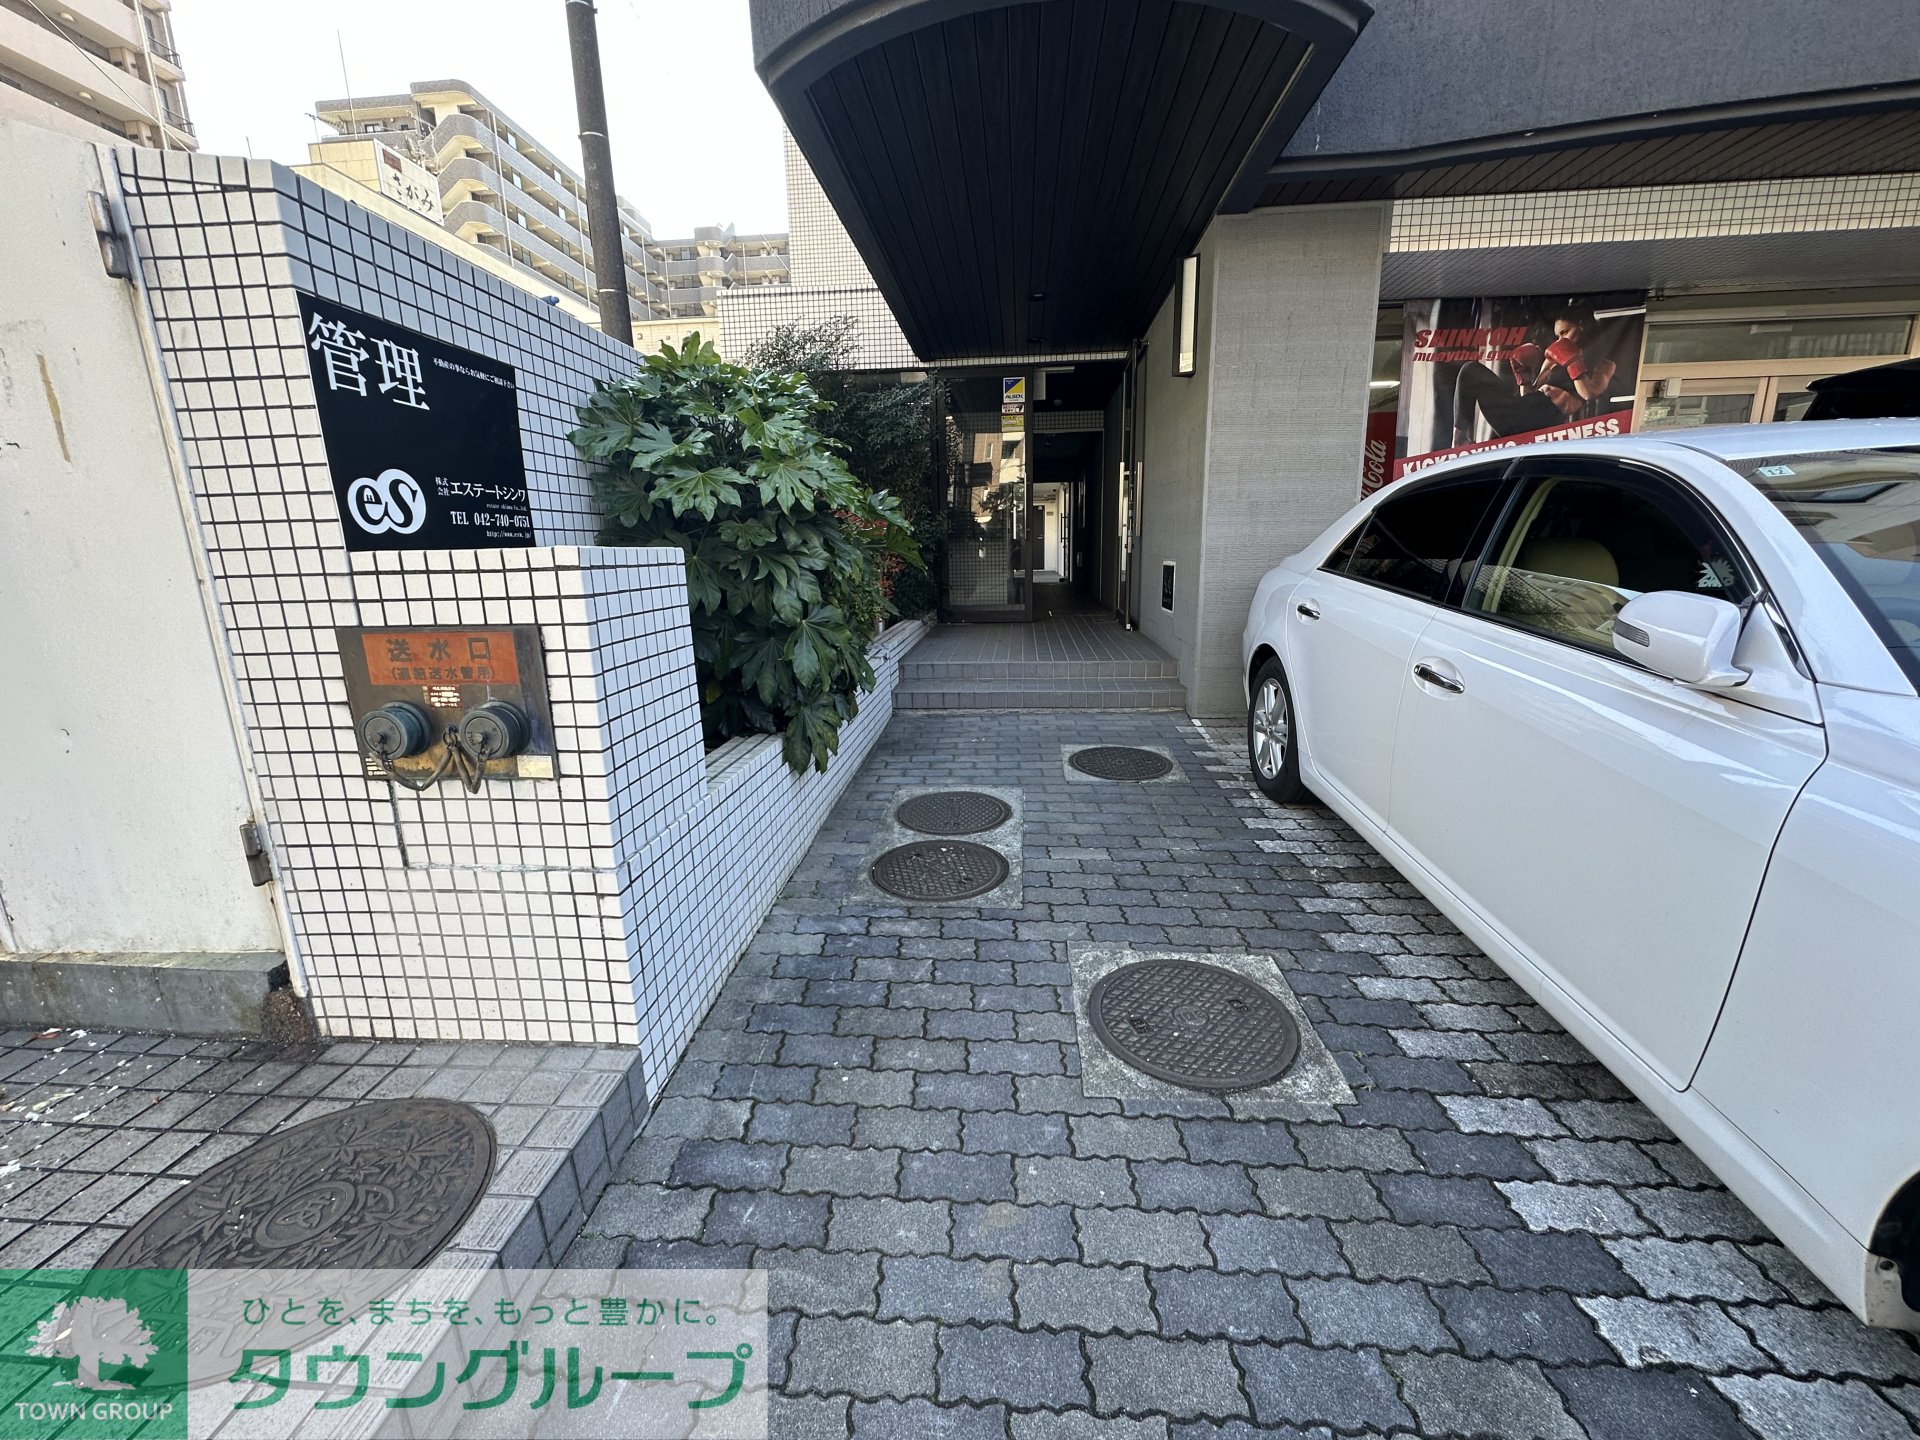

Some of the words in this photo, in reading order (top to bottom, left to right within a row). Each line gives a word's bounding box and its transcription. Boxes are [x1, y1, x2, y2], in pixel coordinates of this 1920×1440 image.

[393, 173, 434, 211] さがみ
[1414, 327, 1527, 348] SHINKOH
[308, 311, 430, 411] 管理
[1534, 418, 1620, 444] FITNESS
[450, 482, 526, 501] エステートシンワ
[450, 511, 469, 525] TEL
[474, 512, 530, 527] 042-740-0751
[386, 638, 490, 662] 送水口
